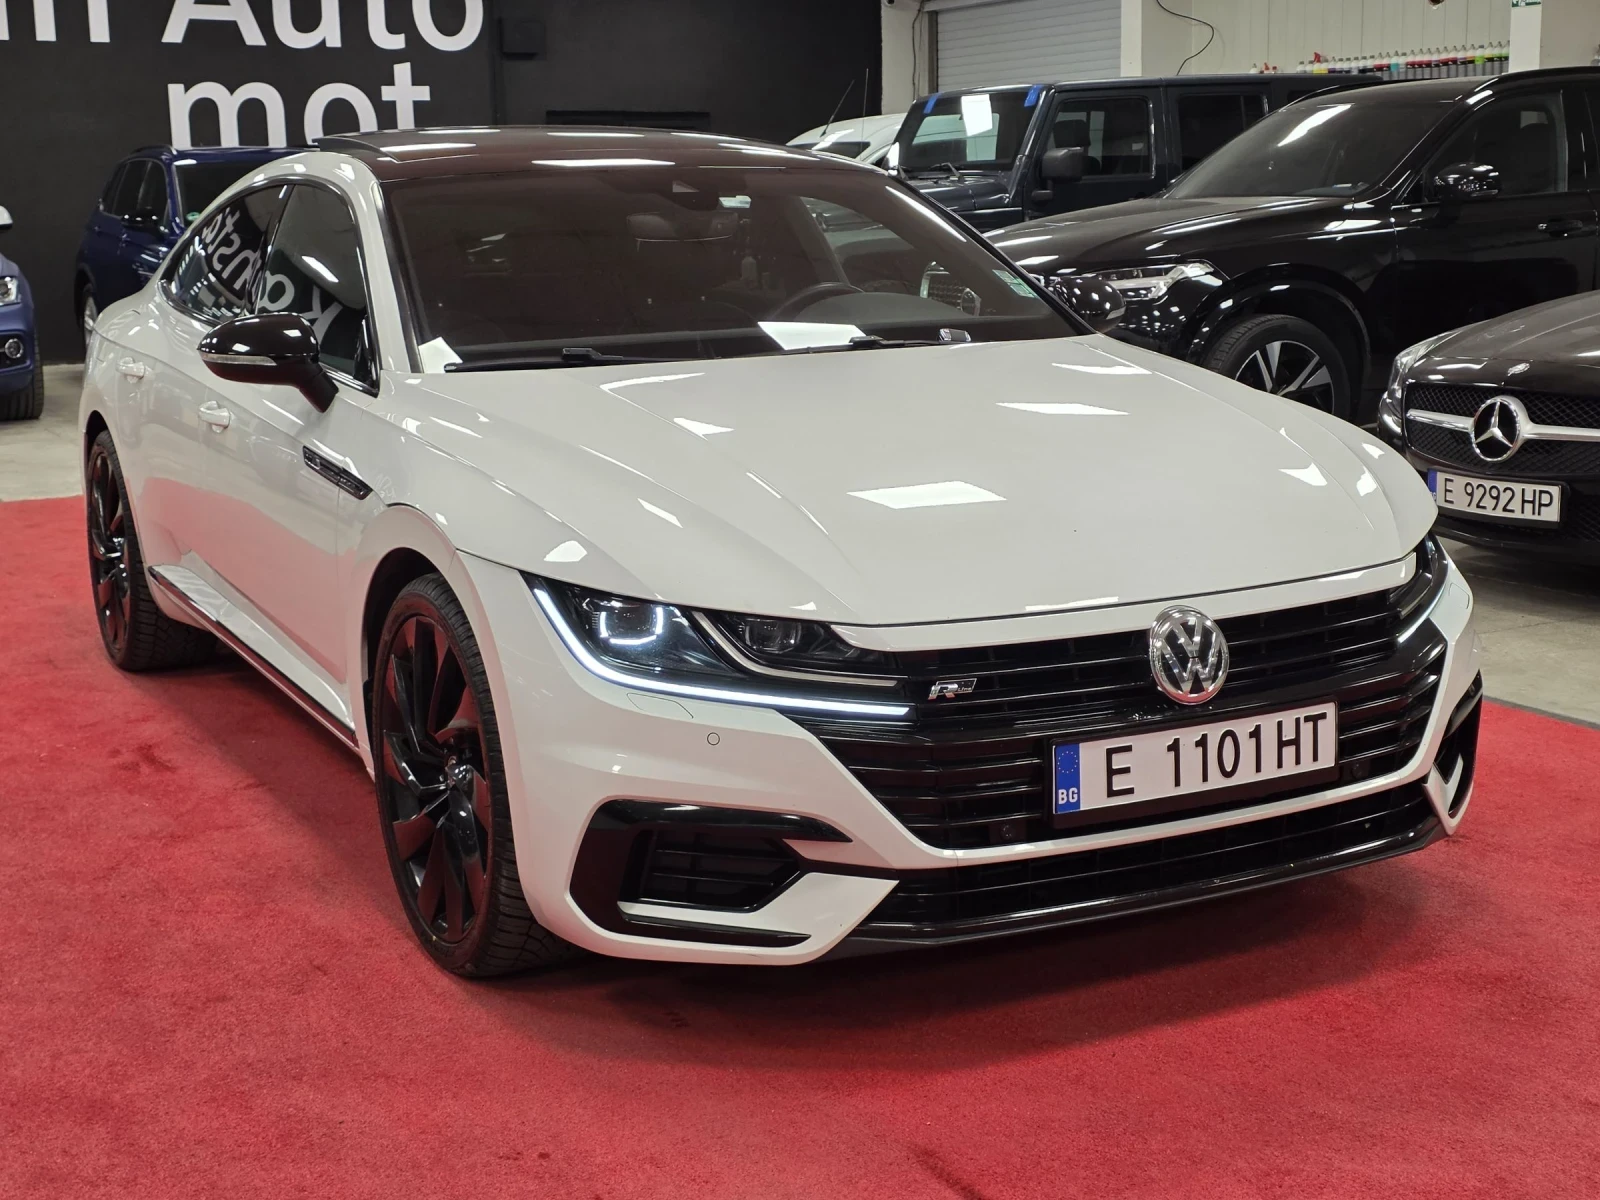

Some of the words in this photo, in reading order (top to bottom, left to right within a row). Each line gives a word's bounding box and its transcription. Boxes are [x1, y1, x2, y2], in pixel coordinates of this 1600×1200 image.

[1444, 478, 1454, 504] E
[1153, 609, 1227, 701] VW
[1105, 744, 1135, 798] E
[1166, 711, 1328, 788] 1101HT
[1058, 787, 1078, 805] BG
